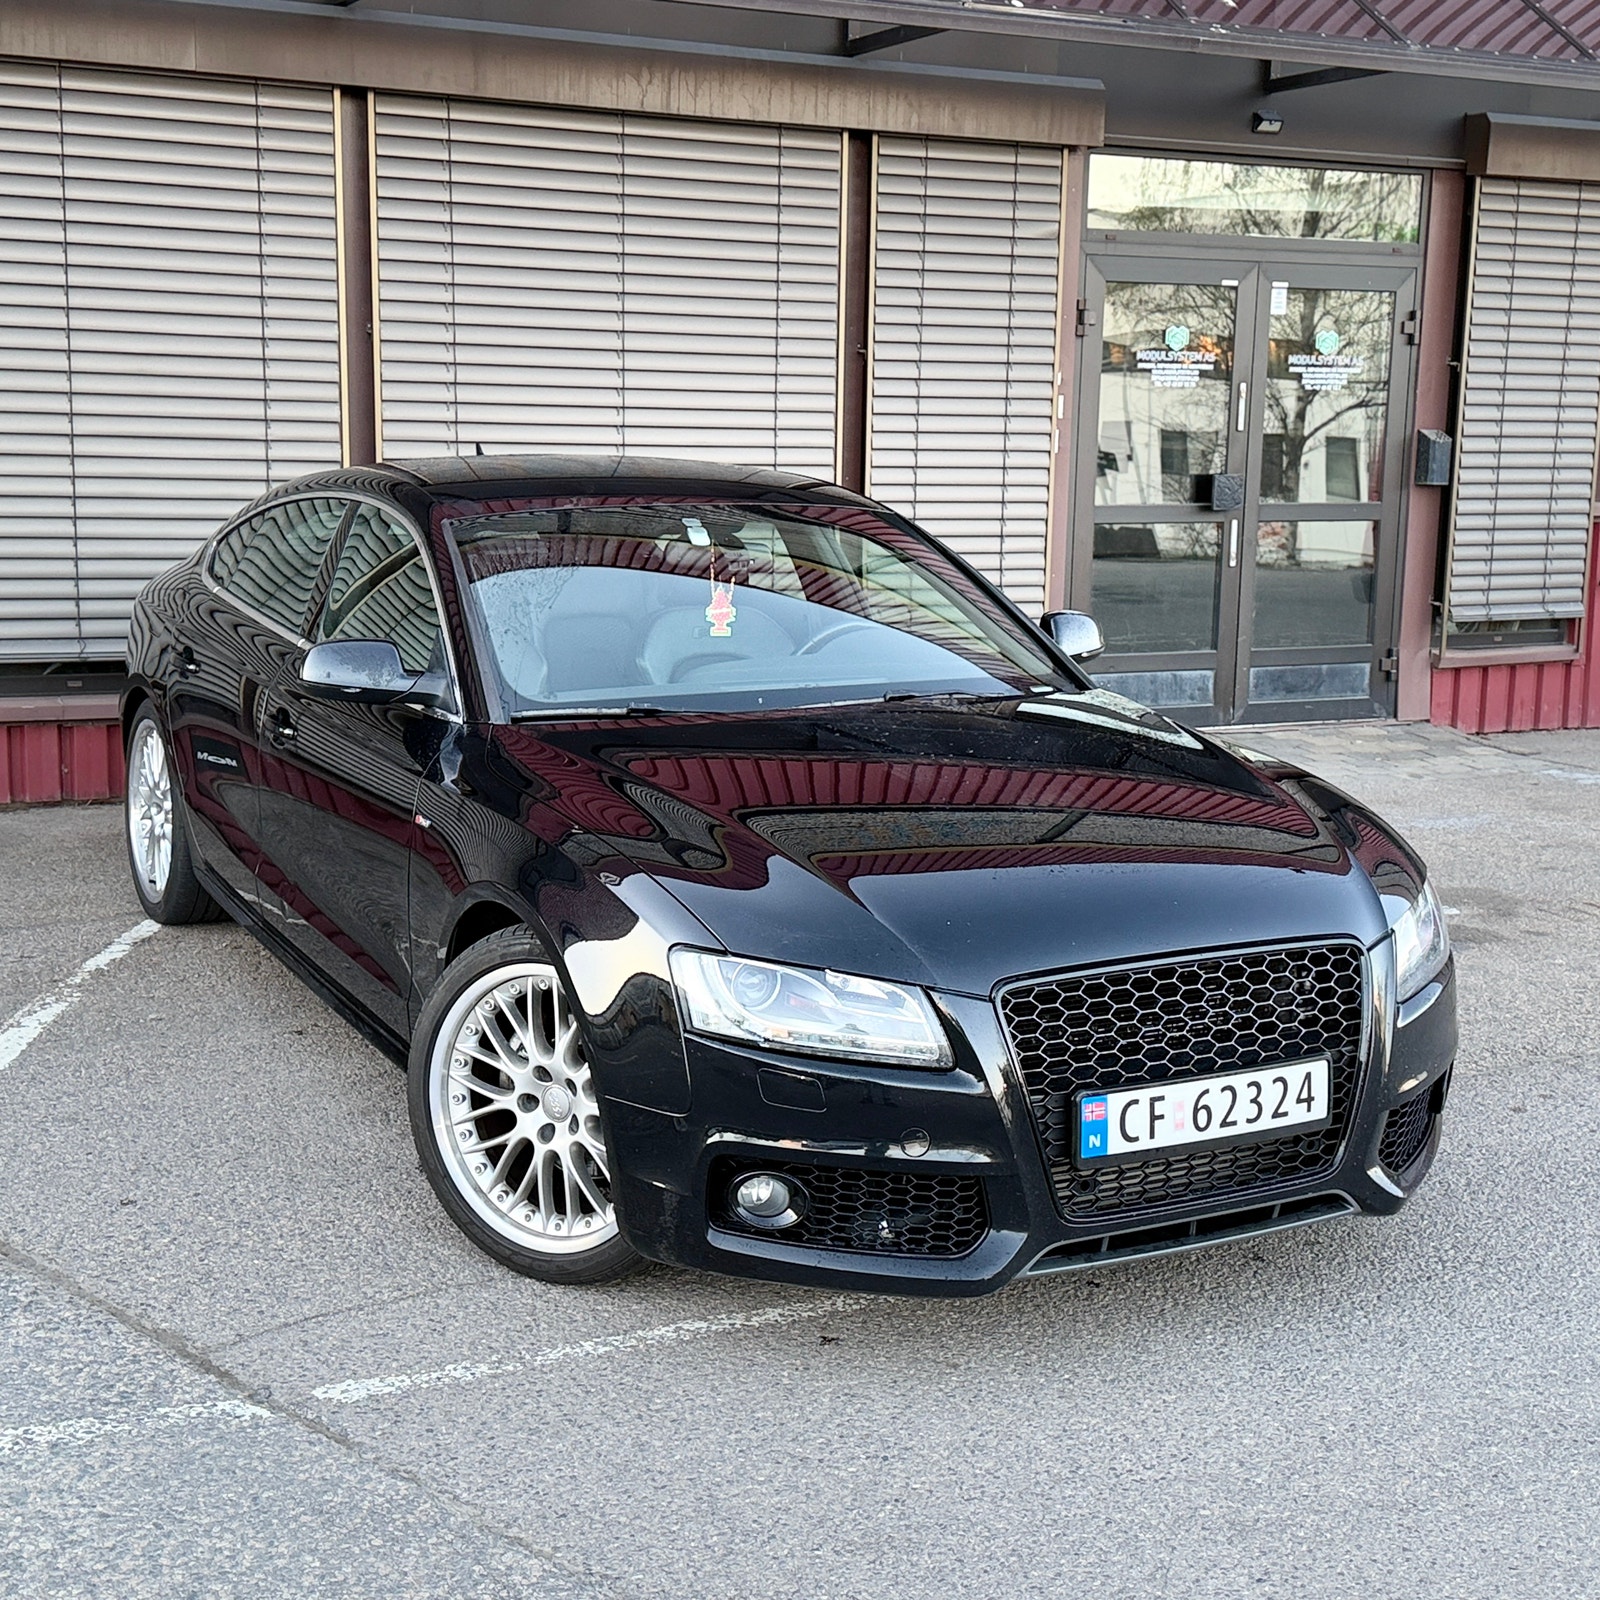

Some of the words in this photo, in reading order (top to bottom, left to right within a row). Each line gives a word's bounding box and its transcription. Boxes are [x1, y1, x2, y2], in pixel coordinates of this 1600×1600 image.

[1136, 350, 1202, 361] MODULSYSTEM
[1287, 354, 1350, 366] MODULSYSTEM
[1119, 1095, 1165, 1143] CF
[1192, 1071, 1315, 1132] 62324
[1088, 1134, 1101, 1149] N
